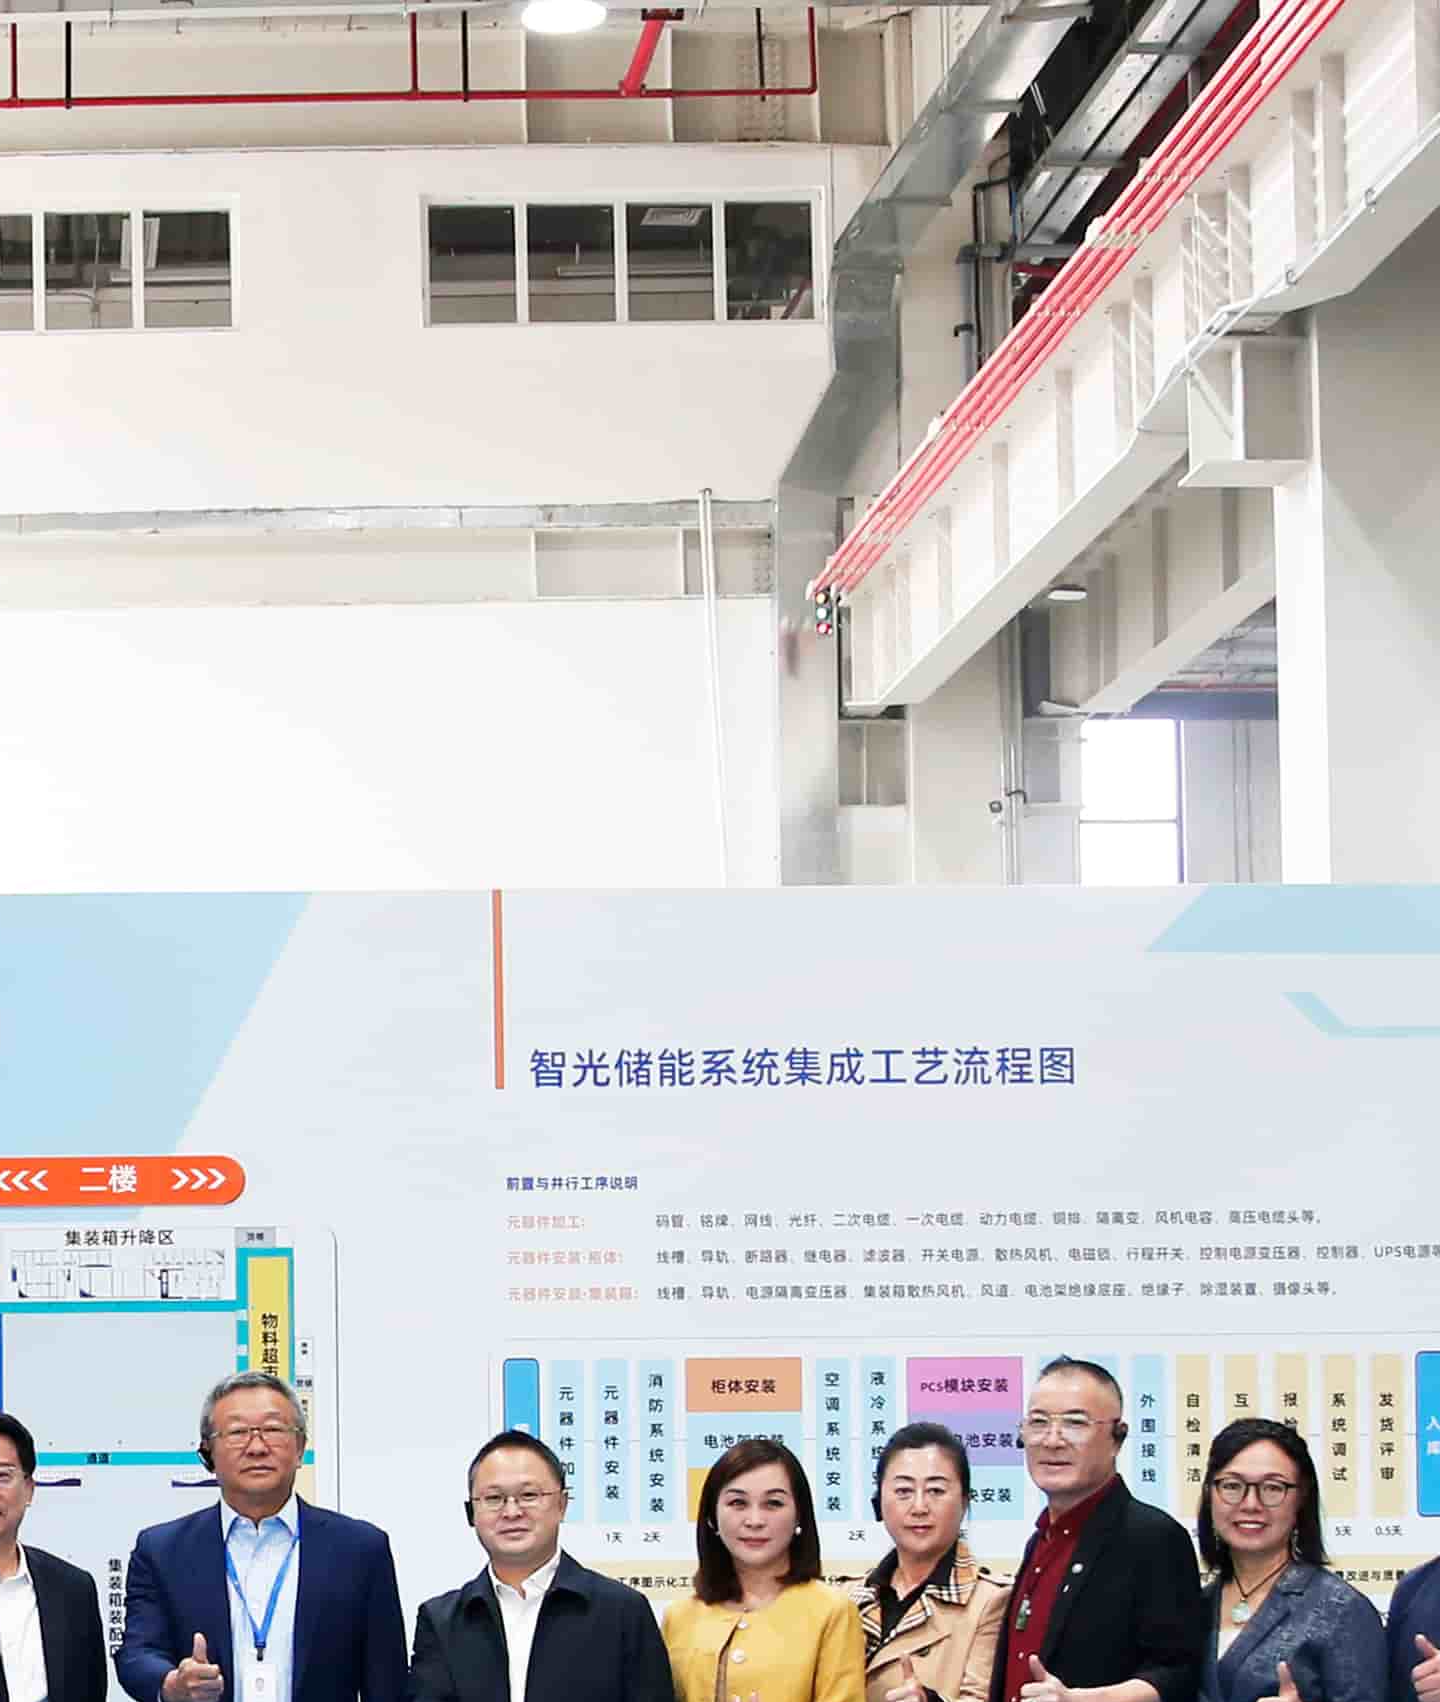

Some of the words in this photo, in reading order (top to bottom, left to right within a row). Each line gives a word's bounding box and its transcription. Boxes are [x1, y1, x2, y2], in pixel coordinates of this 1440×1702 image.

[530, 1046, 1077, 1088] 智光储能系统集成工艺流程图
[79, 1165, 138, 1194] 二楼
[506, 1176, 638, 1191] 前置与并行工序说明
[64, 1229, 175, 1247] 集装箱升降区
[711, 1379, 777, 1394] 柜体安装
[920, 1378, 1009, 1393] PCS模块安装
[603, 1385, 620, 1500] 元器件安装
[648, 1373, 665, 1513] 消防系统安装
[824, 1372, 841, 1512] 空调系统安装
[1139, 1392, 1157, 1484] 外围接线
[1185, 1392, 1202, 1483] 自检清洁
[1331, 1392, 1349, 1483] 系统调试
[1378, 1391, 1396, 1482] 发货评审
[605, 1531, 622, 1544] 1天
[643, 1530, 662, 1543] 2天
[848, 1530, 866, 1542] 2天
[1335, 1525, 1353, 1537] 5天
[1375, 1525, 1404, 1537] 0.5天
